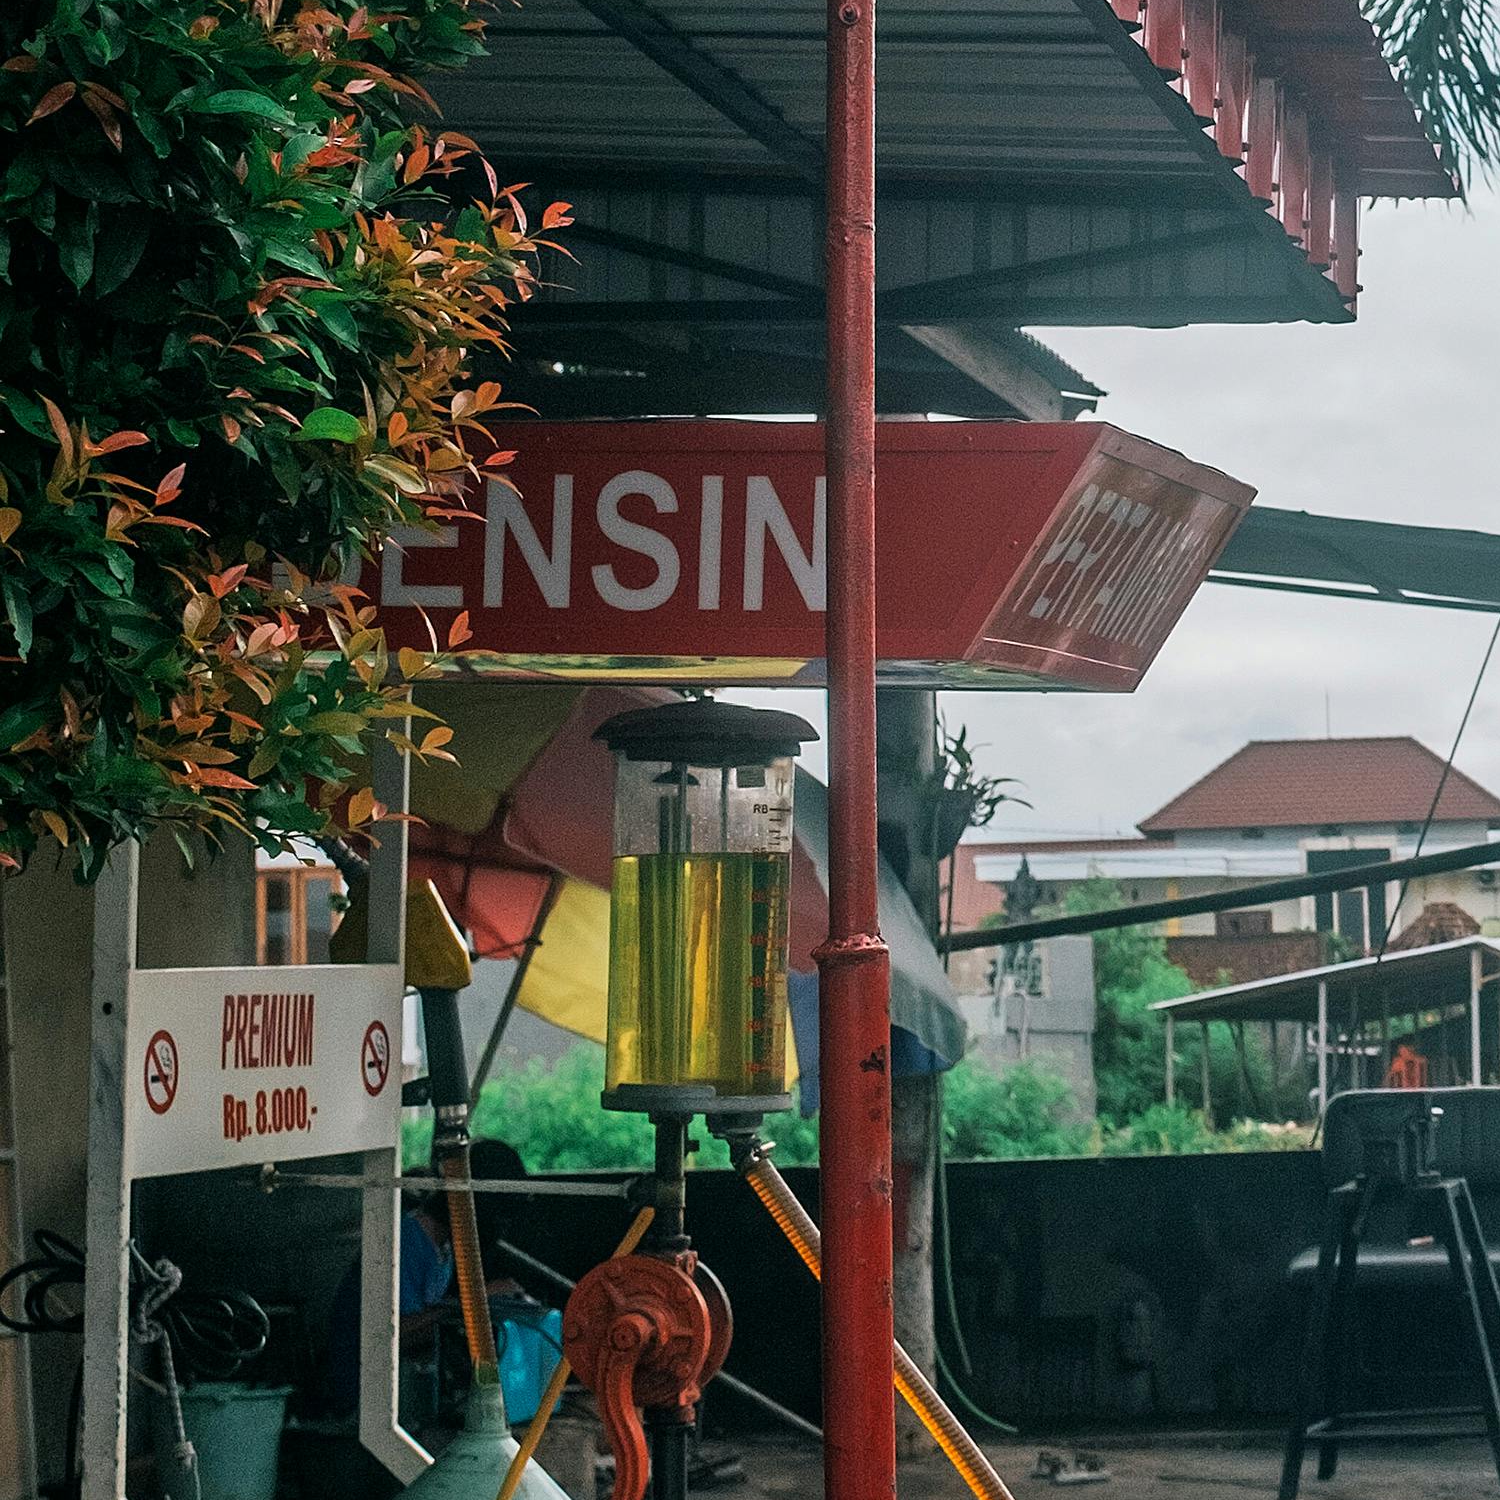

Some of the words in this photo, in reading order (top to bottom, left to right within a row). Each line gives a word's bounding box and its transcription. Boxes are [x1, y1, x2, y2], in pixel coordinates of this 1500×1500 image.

[341, 469, 827, 612] ENSIN
[1011, 482, 1212, 650] PERTAMINI
[221, 993, 315, 1070] PREMIUM
[222, 1094, 252, 1142] Rp.
